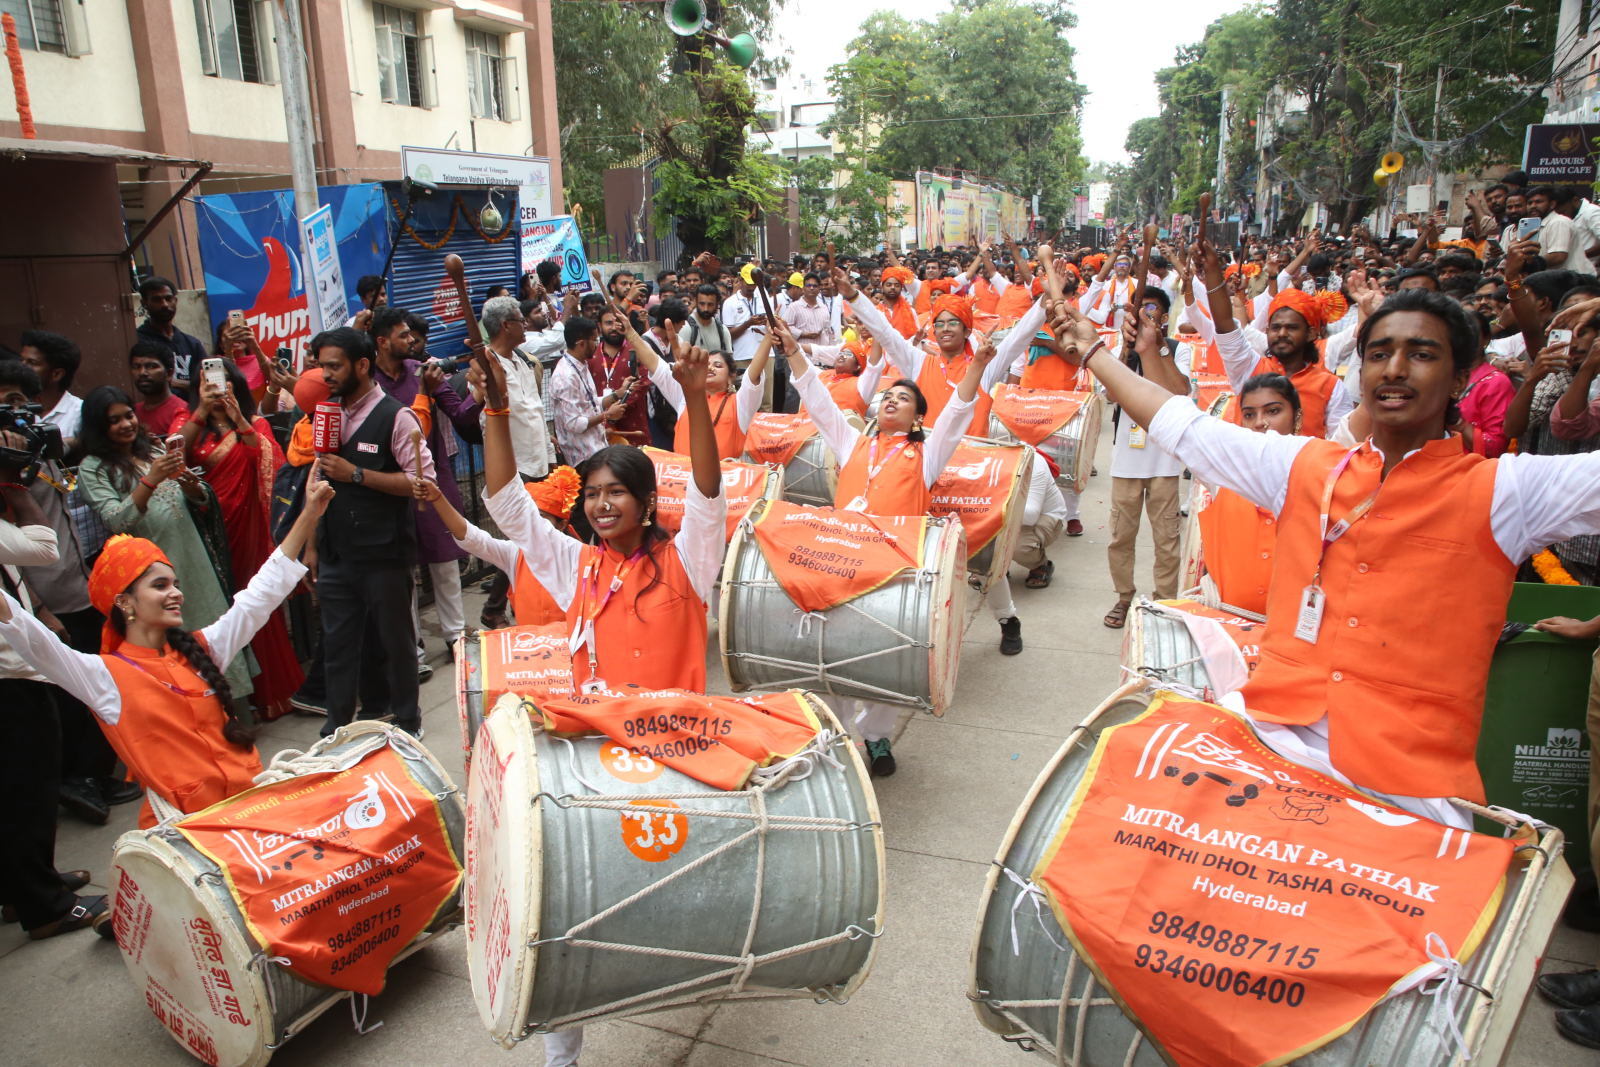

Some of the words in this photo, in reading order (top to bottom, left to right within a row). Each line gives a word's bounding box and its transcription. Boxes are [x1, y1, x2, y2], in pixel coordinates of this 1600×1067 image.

[1530, 167, 1566, 175] BIRYANI
[1567, 166, 1592, 174] CAFE
[1539, 157, 1585, 166] FLAVOURS
[442, 174, 468, 184] Telangana
[469, 176, 485, 184] Vaidya
[246, 308, 311, 343] Thum
[950, 496, 992, 505] PATHAK
[815, 534, 862, 550] Hyderabad
[820, 525, 843, 535] DHOL
[787, 552, 857, 580] 9346006400
[794, 545, 864, 567] 9849887115
[505, 668, 572, 680] MITRAANGA
[623, 714, 733, 739] 9849887115
[610, 746, 656, 775] 33
[1514, 744, 1591, 758] Nilkama
[1514, 760, 1552, 768] MATERIAL
[635, 809, 678, 848] 33
[1120, 804, 1304, 865] MITRAANGAN
[1300, 847, 1440, 904] PATHAK
[271, 856, 373, 912] MITRAANGAN
[375, 835, 423, 868] PATHAK
[1113, 829, 1200, 865] MARATHI
[1202, 852, 1259, 881] DHOL
[1267, 868, 1334, 896] TASHA
[1340, 882, 1426, 920] GROUP
[280, 893, 334, 926] MARATHI
[334, 882, 363, 901] DHOL
[364, 868, 394, 888] TASHA
[395, 851, 426, 875] GROUP
[337, 885, 390, 916] Hyderabad
[1191, 875, 1308, 918] Hyderabad
[327, 904, 402, 953] 9849887115
[1147, 910, 1320, 970] 9849887115
[329, 924, 400, 975] 9346006400
[1133, 943, 1306, 1008] 9346006400
